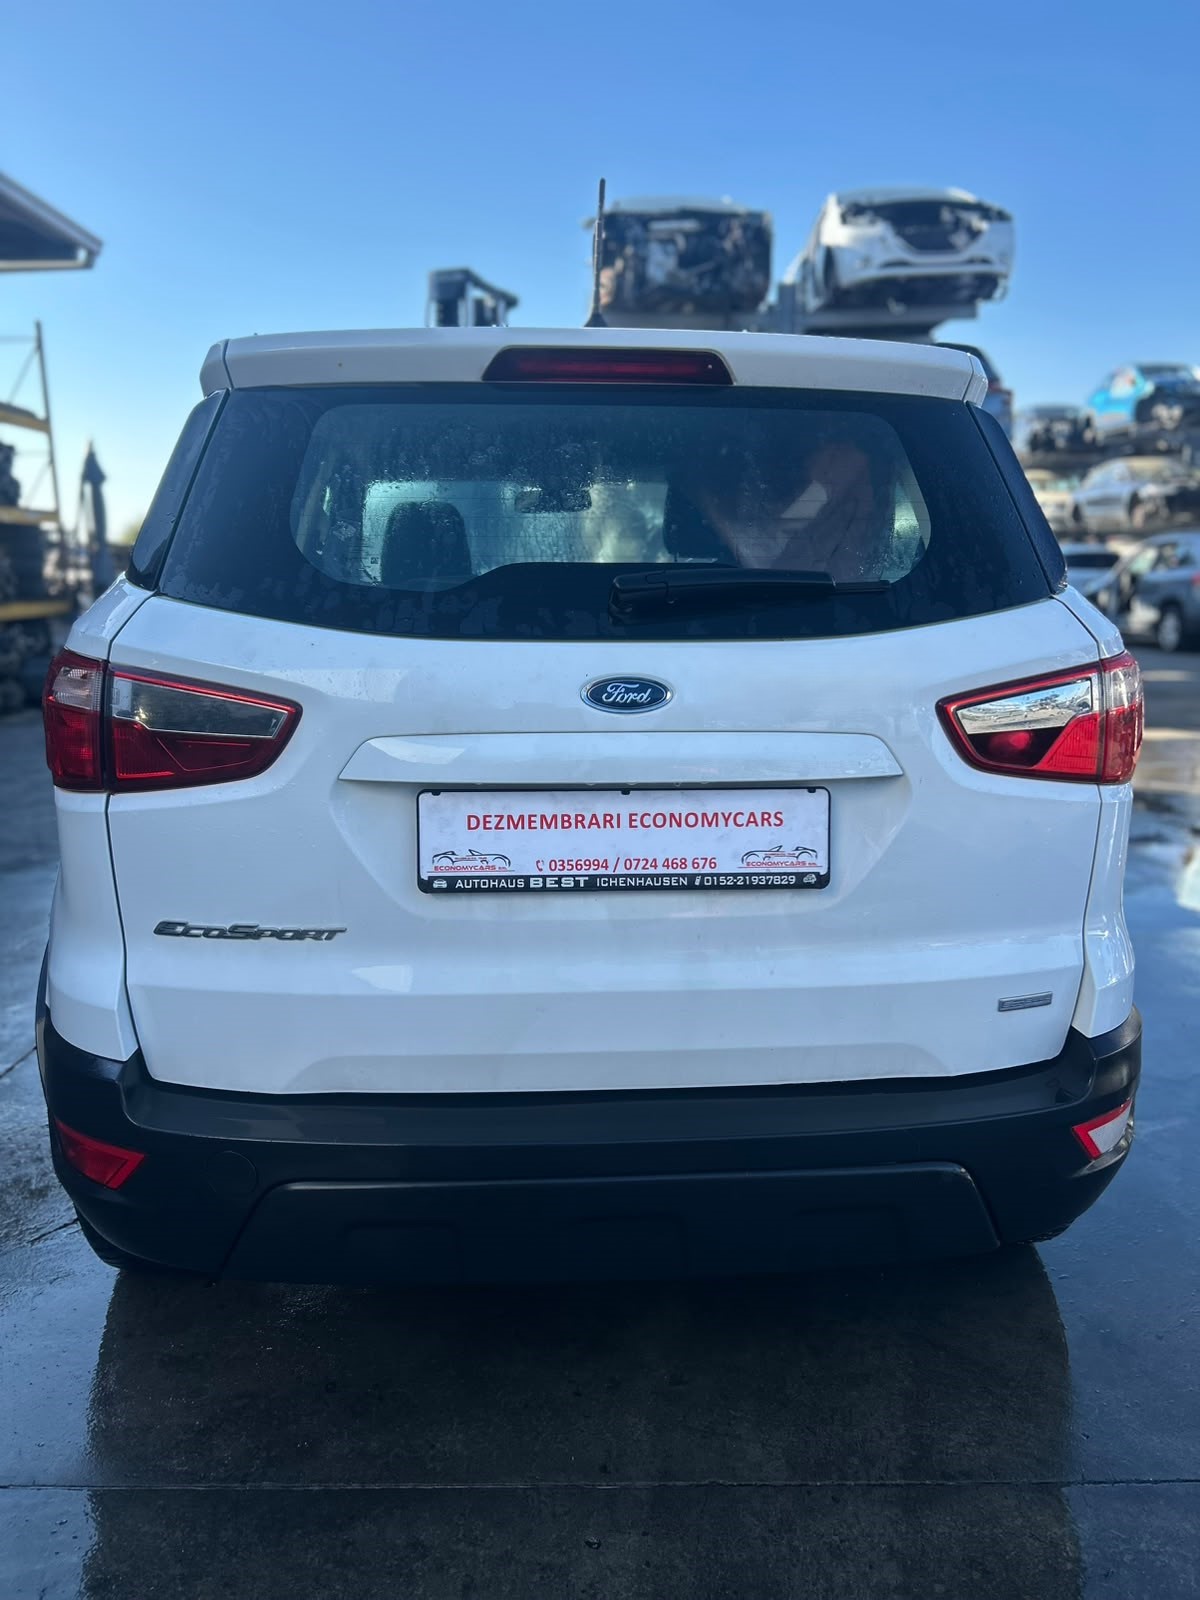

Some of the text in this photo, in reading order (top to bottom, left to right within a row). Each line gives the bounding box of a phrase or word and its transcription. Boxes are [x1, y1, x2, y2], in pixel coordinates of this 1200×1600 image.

[602, 683, 651, 703] Ford
[466, 811, 784, 831] DEZMEMBRARI ECONOMYCARS
[548, 859, 609, 871] 0356994
[624, 858, 658, 870] 0724
[662, 857, 688, 870] 468
[692, 857, 717, 869] 676
[455, 876, 796, 888] AUTOHAUS BEST ICHENHAUSEN 0152-21937829
